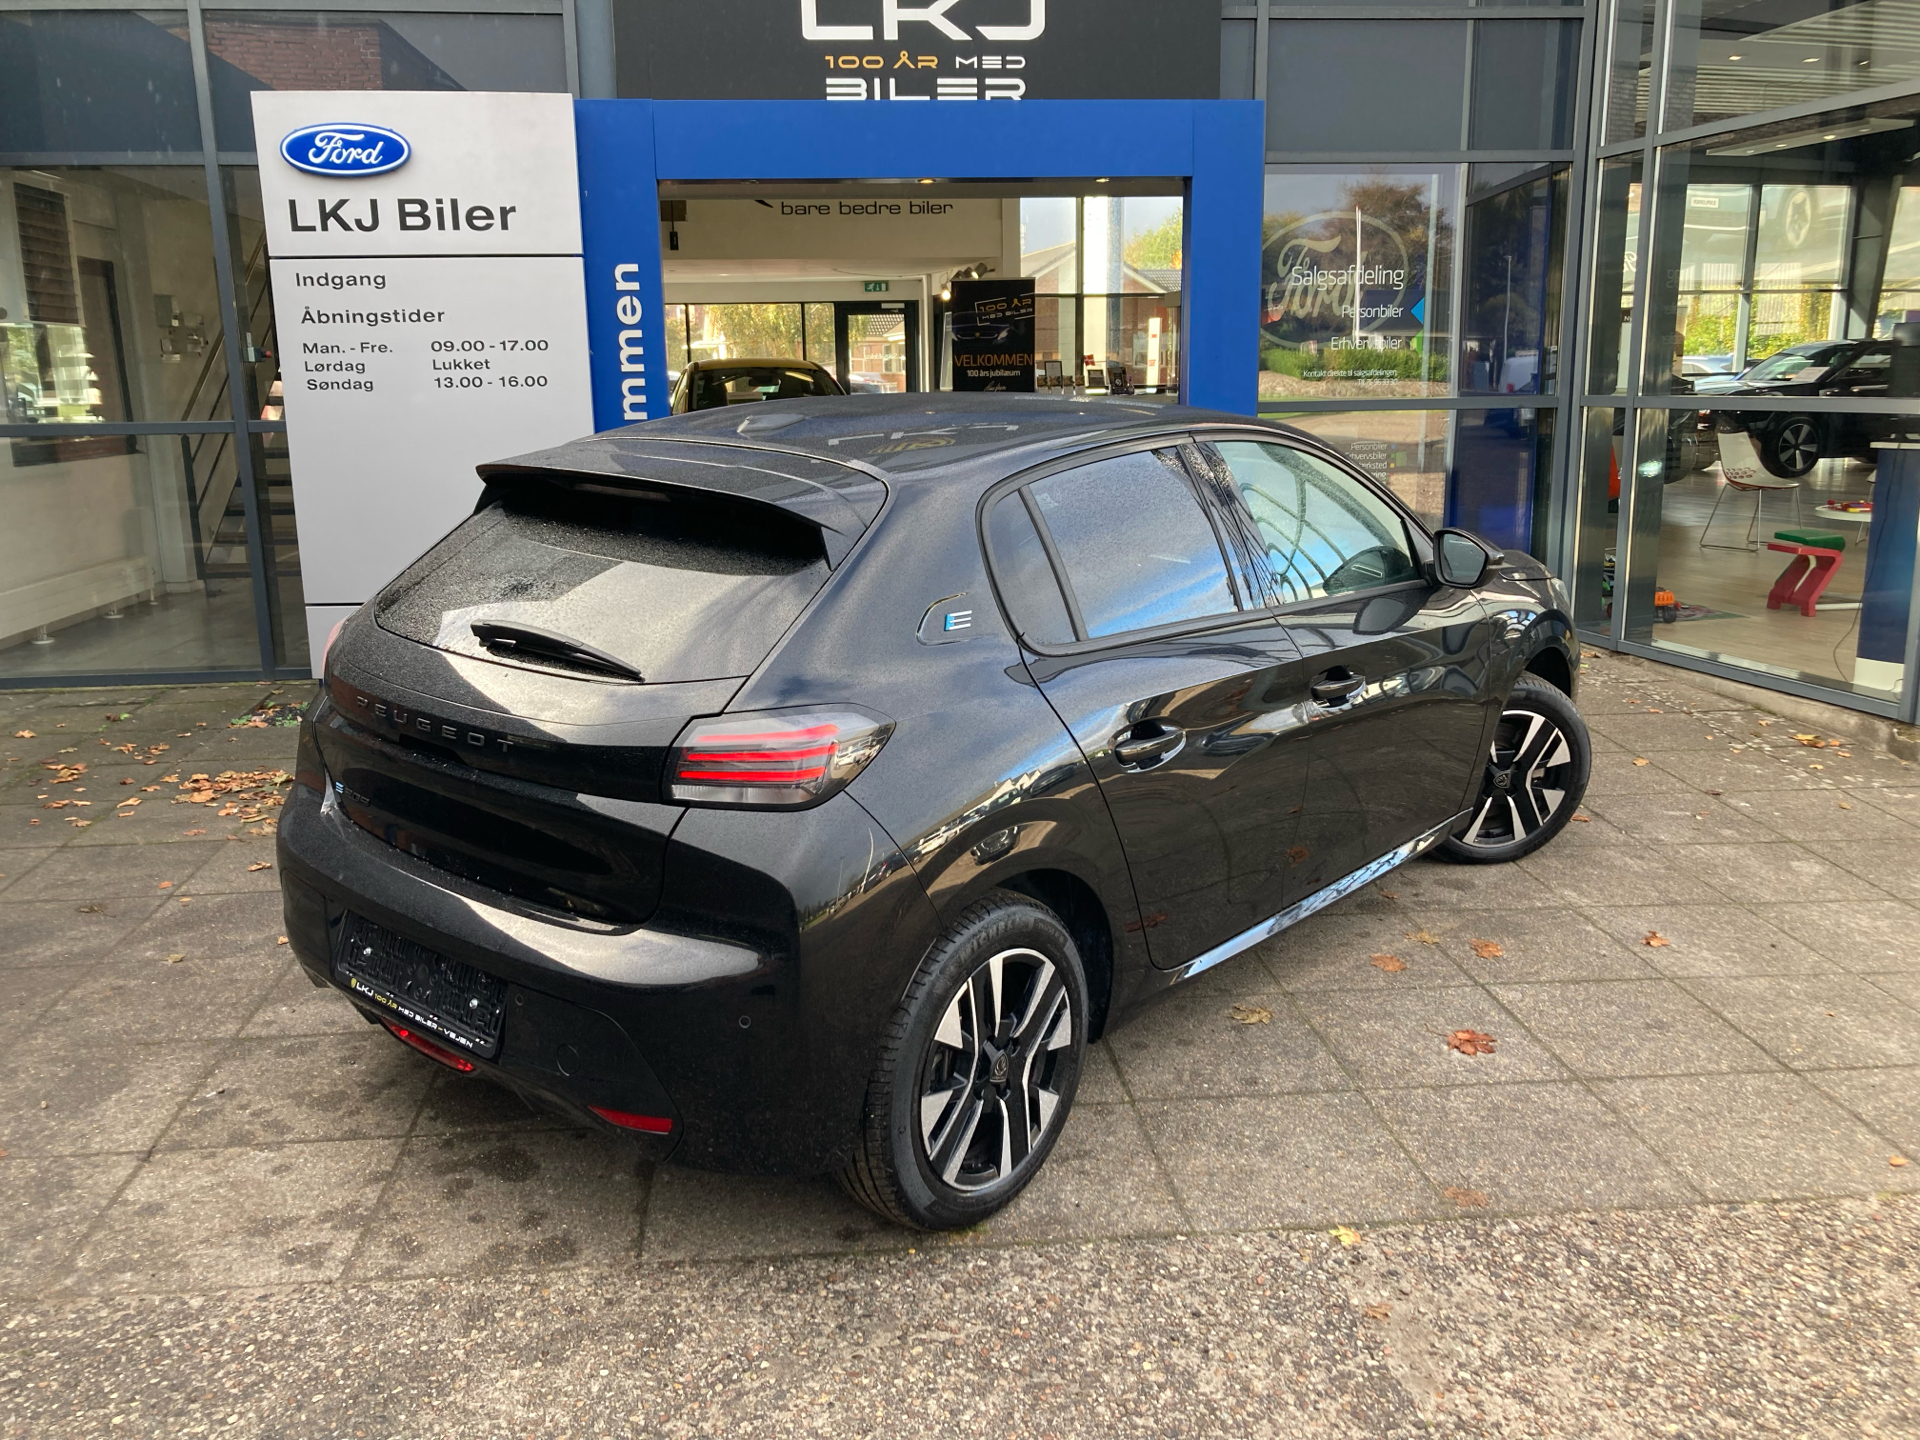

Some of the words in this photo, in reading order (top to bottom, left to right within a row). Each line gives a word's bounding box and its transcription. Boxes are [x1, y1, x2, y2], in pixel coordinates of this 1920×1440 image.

[801, 0, 1046, 41] LKJ
[824, 55, 885, 69] 100
[893, 50, 939, 69] ÅR
[955, 55, 1026, 69] MED
[825, 77, 1027, 101] BILER
[307, 130, 385, 165] Ford
[288, 197, 381, 233] LKJ
[396, 197, 517, 232] Biler
[780, 201, 831, 216] bare
[838, 200, 902, 216] bedre
[909, 200, 954, 216] biler
[294, 272, 387, 290] Indgang
[1291, 264, 1405, 291] Salgsafdeling
[300, 305, 446, 327] Åbningstider
[979, 302, 1008, 312] 100
[981, 312, 1003, 320] MED
[1005, 307, 1033, 316] BILER
[1341, 303, 1404, 318] Personbiler
[301, 341, 346, 354] Man.
[359, 341, 394, 354] Fre.
[430, 339, 486, 353] 09.00
[498, 338, 550, 352] 17.00
[613, 263, 649, 421] mmen
[304, 360, 367, 375] Lørdag
[432, 357, 491, 371] Lukket
[953, 353, 1034, 367] VELKOMMEN
[967, 369, 979, 377] 100
[979, 368, 990, 377] års
[990, 368, 1021, 378] jubilæum
[1303, 369, 1326, 378] Kontakt
[1327, 369, 1347, 377] direkte
[306, 378, 375, 392] Søndag
[433, 376, 483, 389] 13.00
[498, 374, 549, 388] 16.00
[1345, 451, 1387, 460] rhvervsbiler
[1350, 442, 1388, 451] Personbiler
[356, 695, 514, 753] PEUGEOT
[356, 982, 374, 997] LKJ
[374, 993, 387, 1004] 100
[397, 1006, 415, 1018] MED
[414, 1014, 438, 1030] BILER
[443, 1028, 474, 1049] VEJEN
